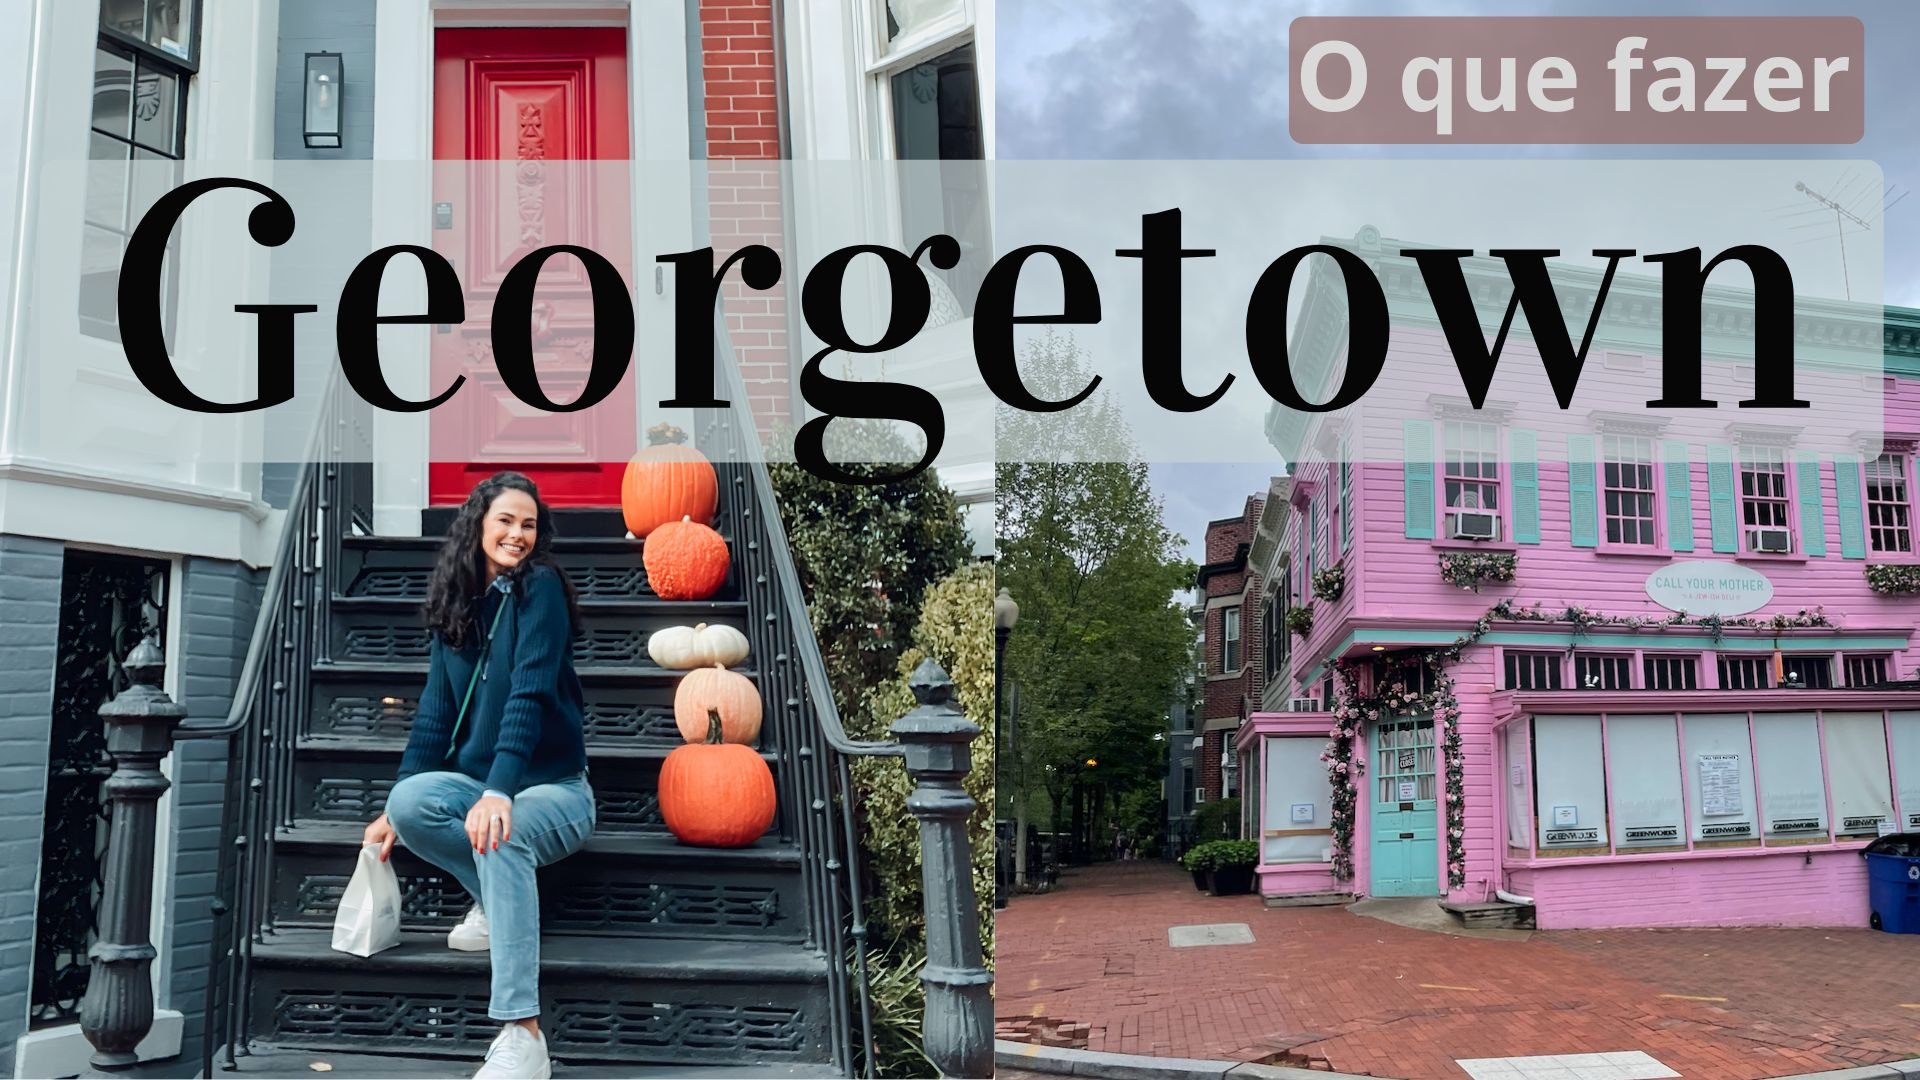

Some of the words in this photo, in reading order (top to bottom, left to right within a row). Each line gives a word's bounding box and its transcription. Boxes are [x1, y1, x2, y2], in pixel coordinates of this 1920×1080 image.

[1655, 577, 1683, 589] CALL
[1686, 578, 1715, 590] YOUR
[1719, 579, 1764, 592] MOTHER
[1702, 826, 1751, 834] GREENWORKS
[1773, 822, 1820, 830] GREENWORKS
[1626, 829, 1678, 839] GREENWORKS
